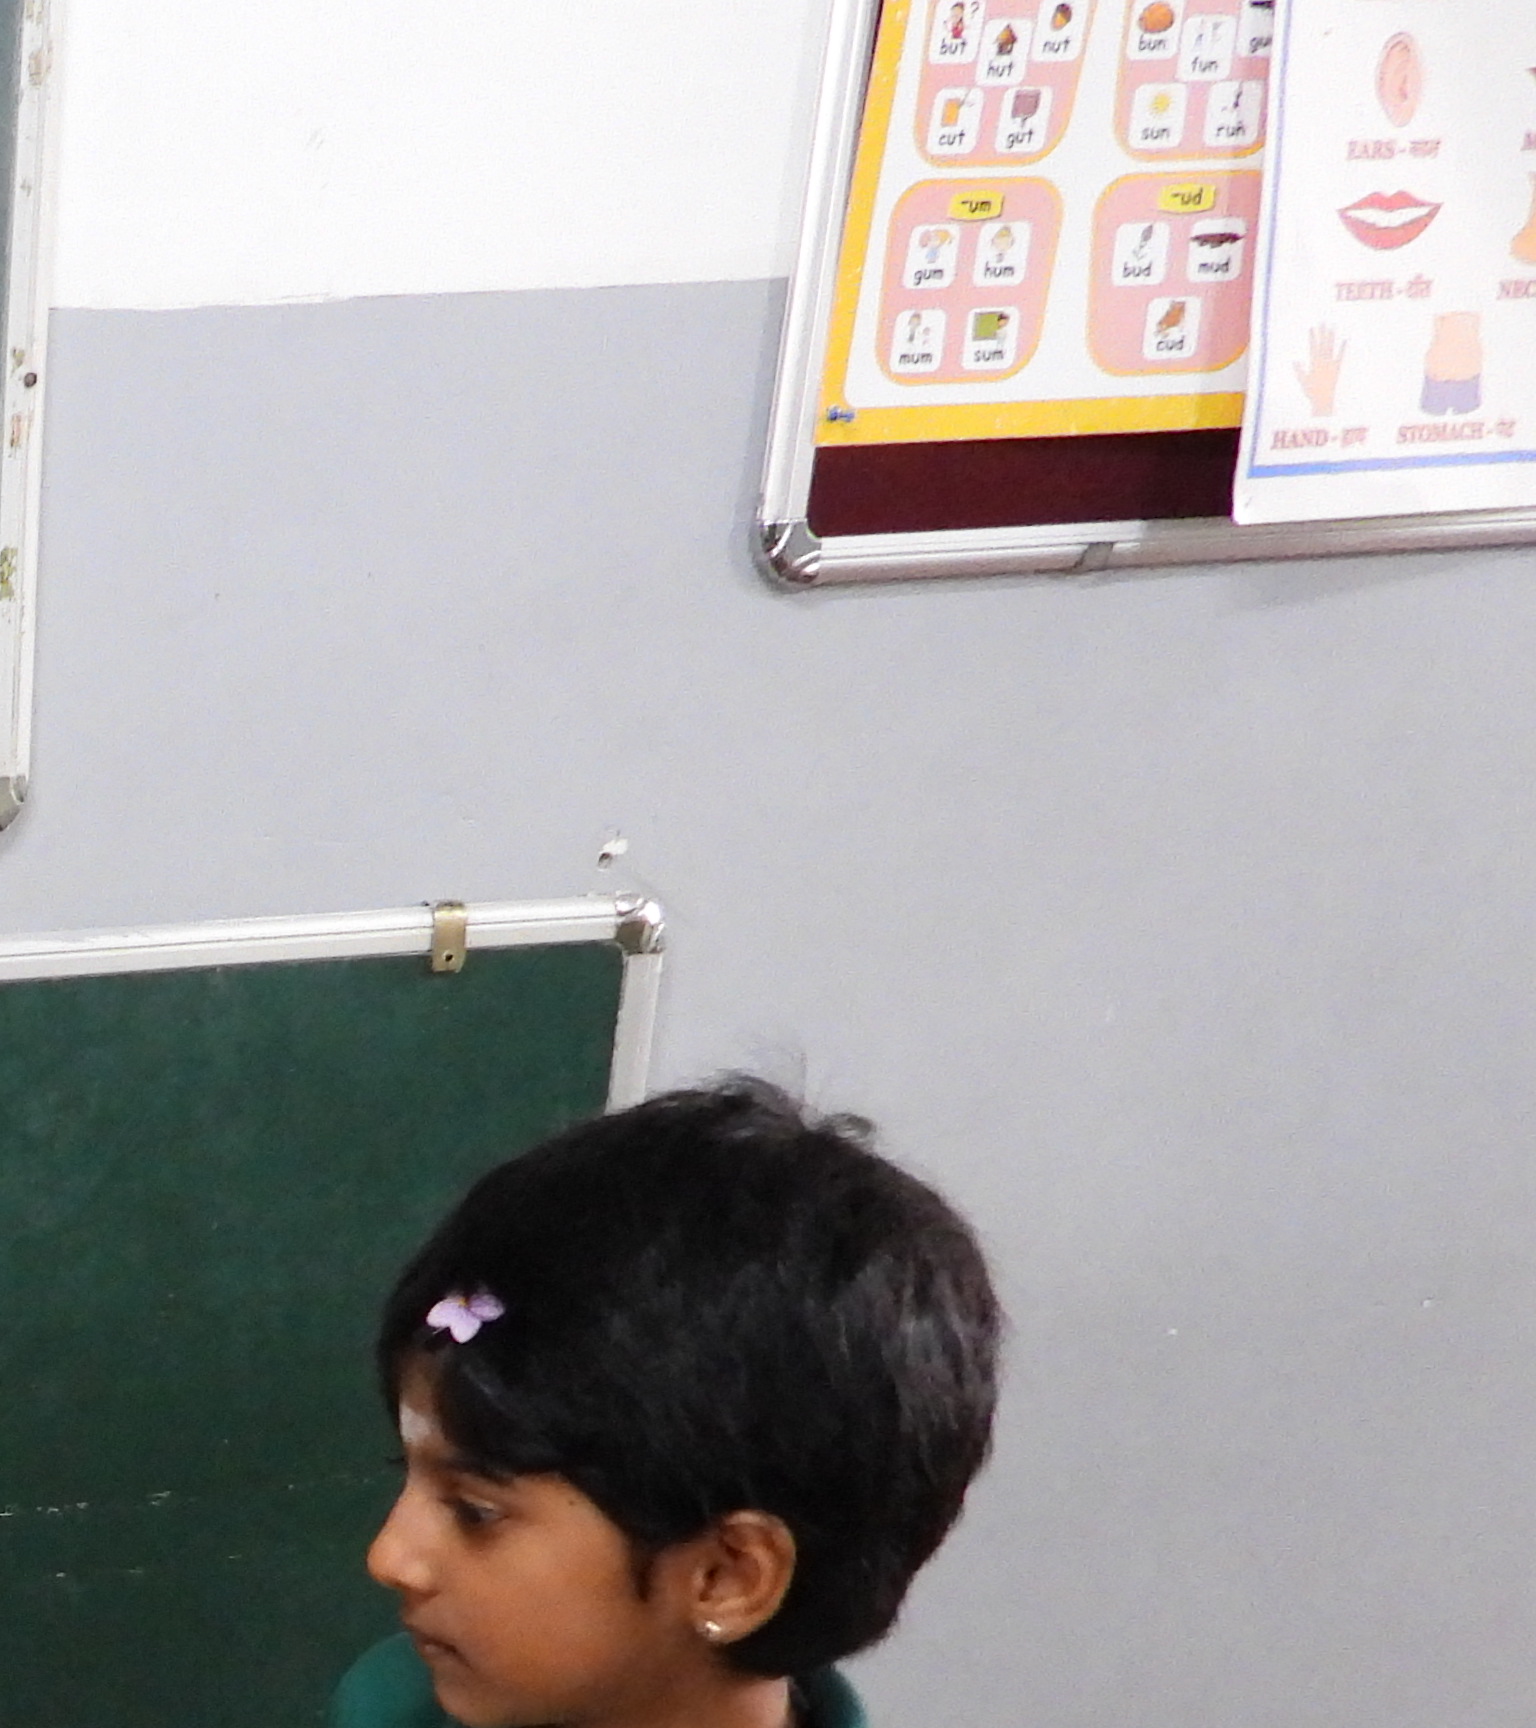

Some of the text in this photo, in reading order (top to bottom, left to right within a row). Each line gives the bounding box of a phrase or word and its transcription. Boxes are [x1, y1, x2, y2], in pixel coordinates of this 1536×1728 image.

[938, 37, 967, 56] but
[1042, 37, 1070, 54] nut
[1137, 34, 1167, 52] bun
[1249, 34, 1273, 53] gu
[987, 60, 1016, 77] hut
[1190, 56, 1218, 74] fun
[938, 130, 966, 147] cut
[1006, 128, 1036, 149] gut
[1140, 123, 1170, 141] sun
[1215, 120, 1247, 139] run
[983, 261, 1016, 279] hum
[1122, 261, 1153, 279] bud
[1197, 256, 1232, 275] mud
[913, 266, 945, 287] gum
[1156, 337, 1187, 353] cud
[898, 349, 934, 366] mum
[973, 347, 1005, 363] sum
[1269, 426, 1329, 452] HAND
